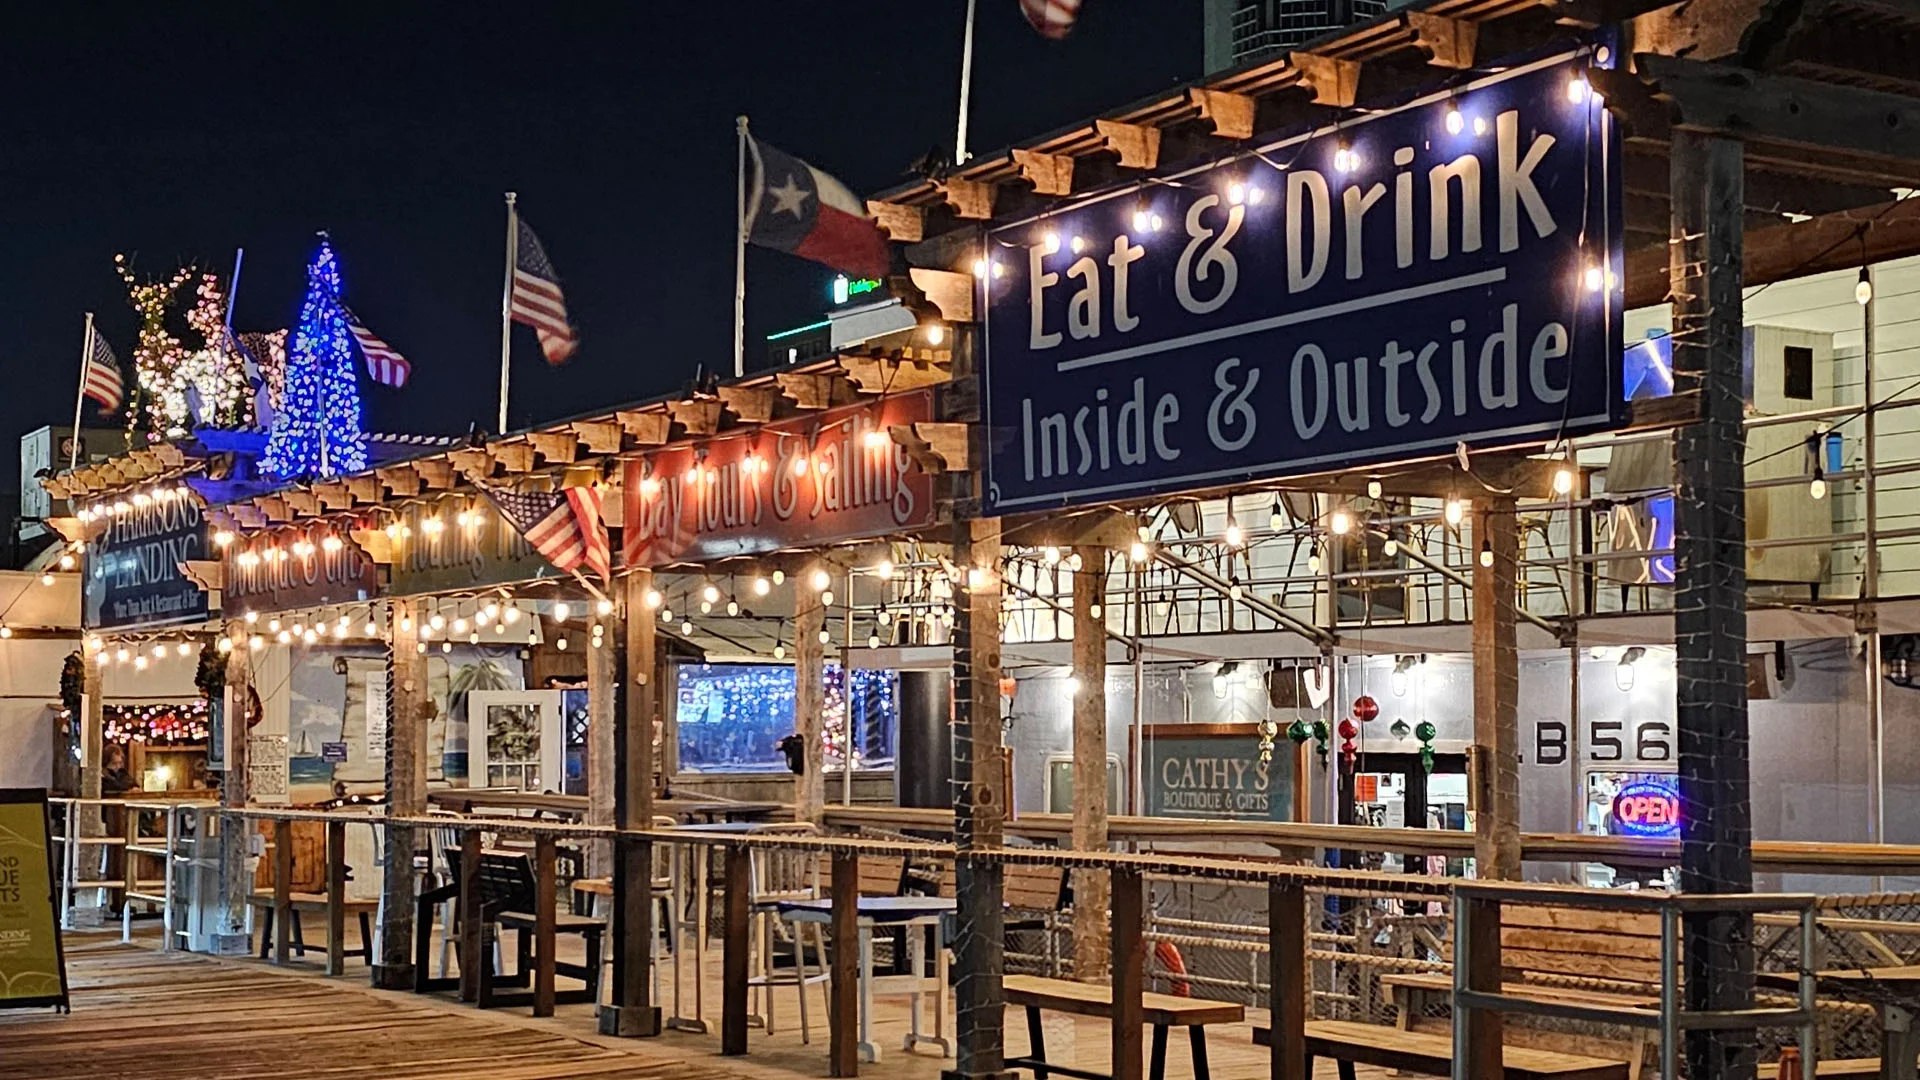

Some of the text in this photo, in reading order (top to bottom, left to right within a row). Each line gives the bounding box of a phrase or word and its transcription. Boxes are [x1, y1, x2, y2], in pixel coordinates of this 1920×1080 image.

[1028, 109, 1558, 351] Eat & Drink
[1022, 303, 1570, 481] Inside & Outside
[773, 435, 799, 520] &
[810, 413, 914, 523] Sailing
[1163, 791, 1269, 810] BOUTIQUE & GIFTS
[1619, 796, 1680, 826] OPEN
